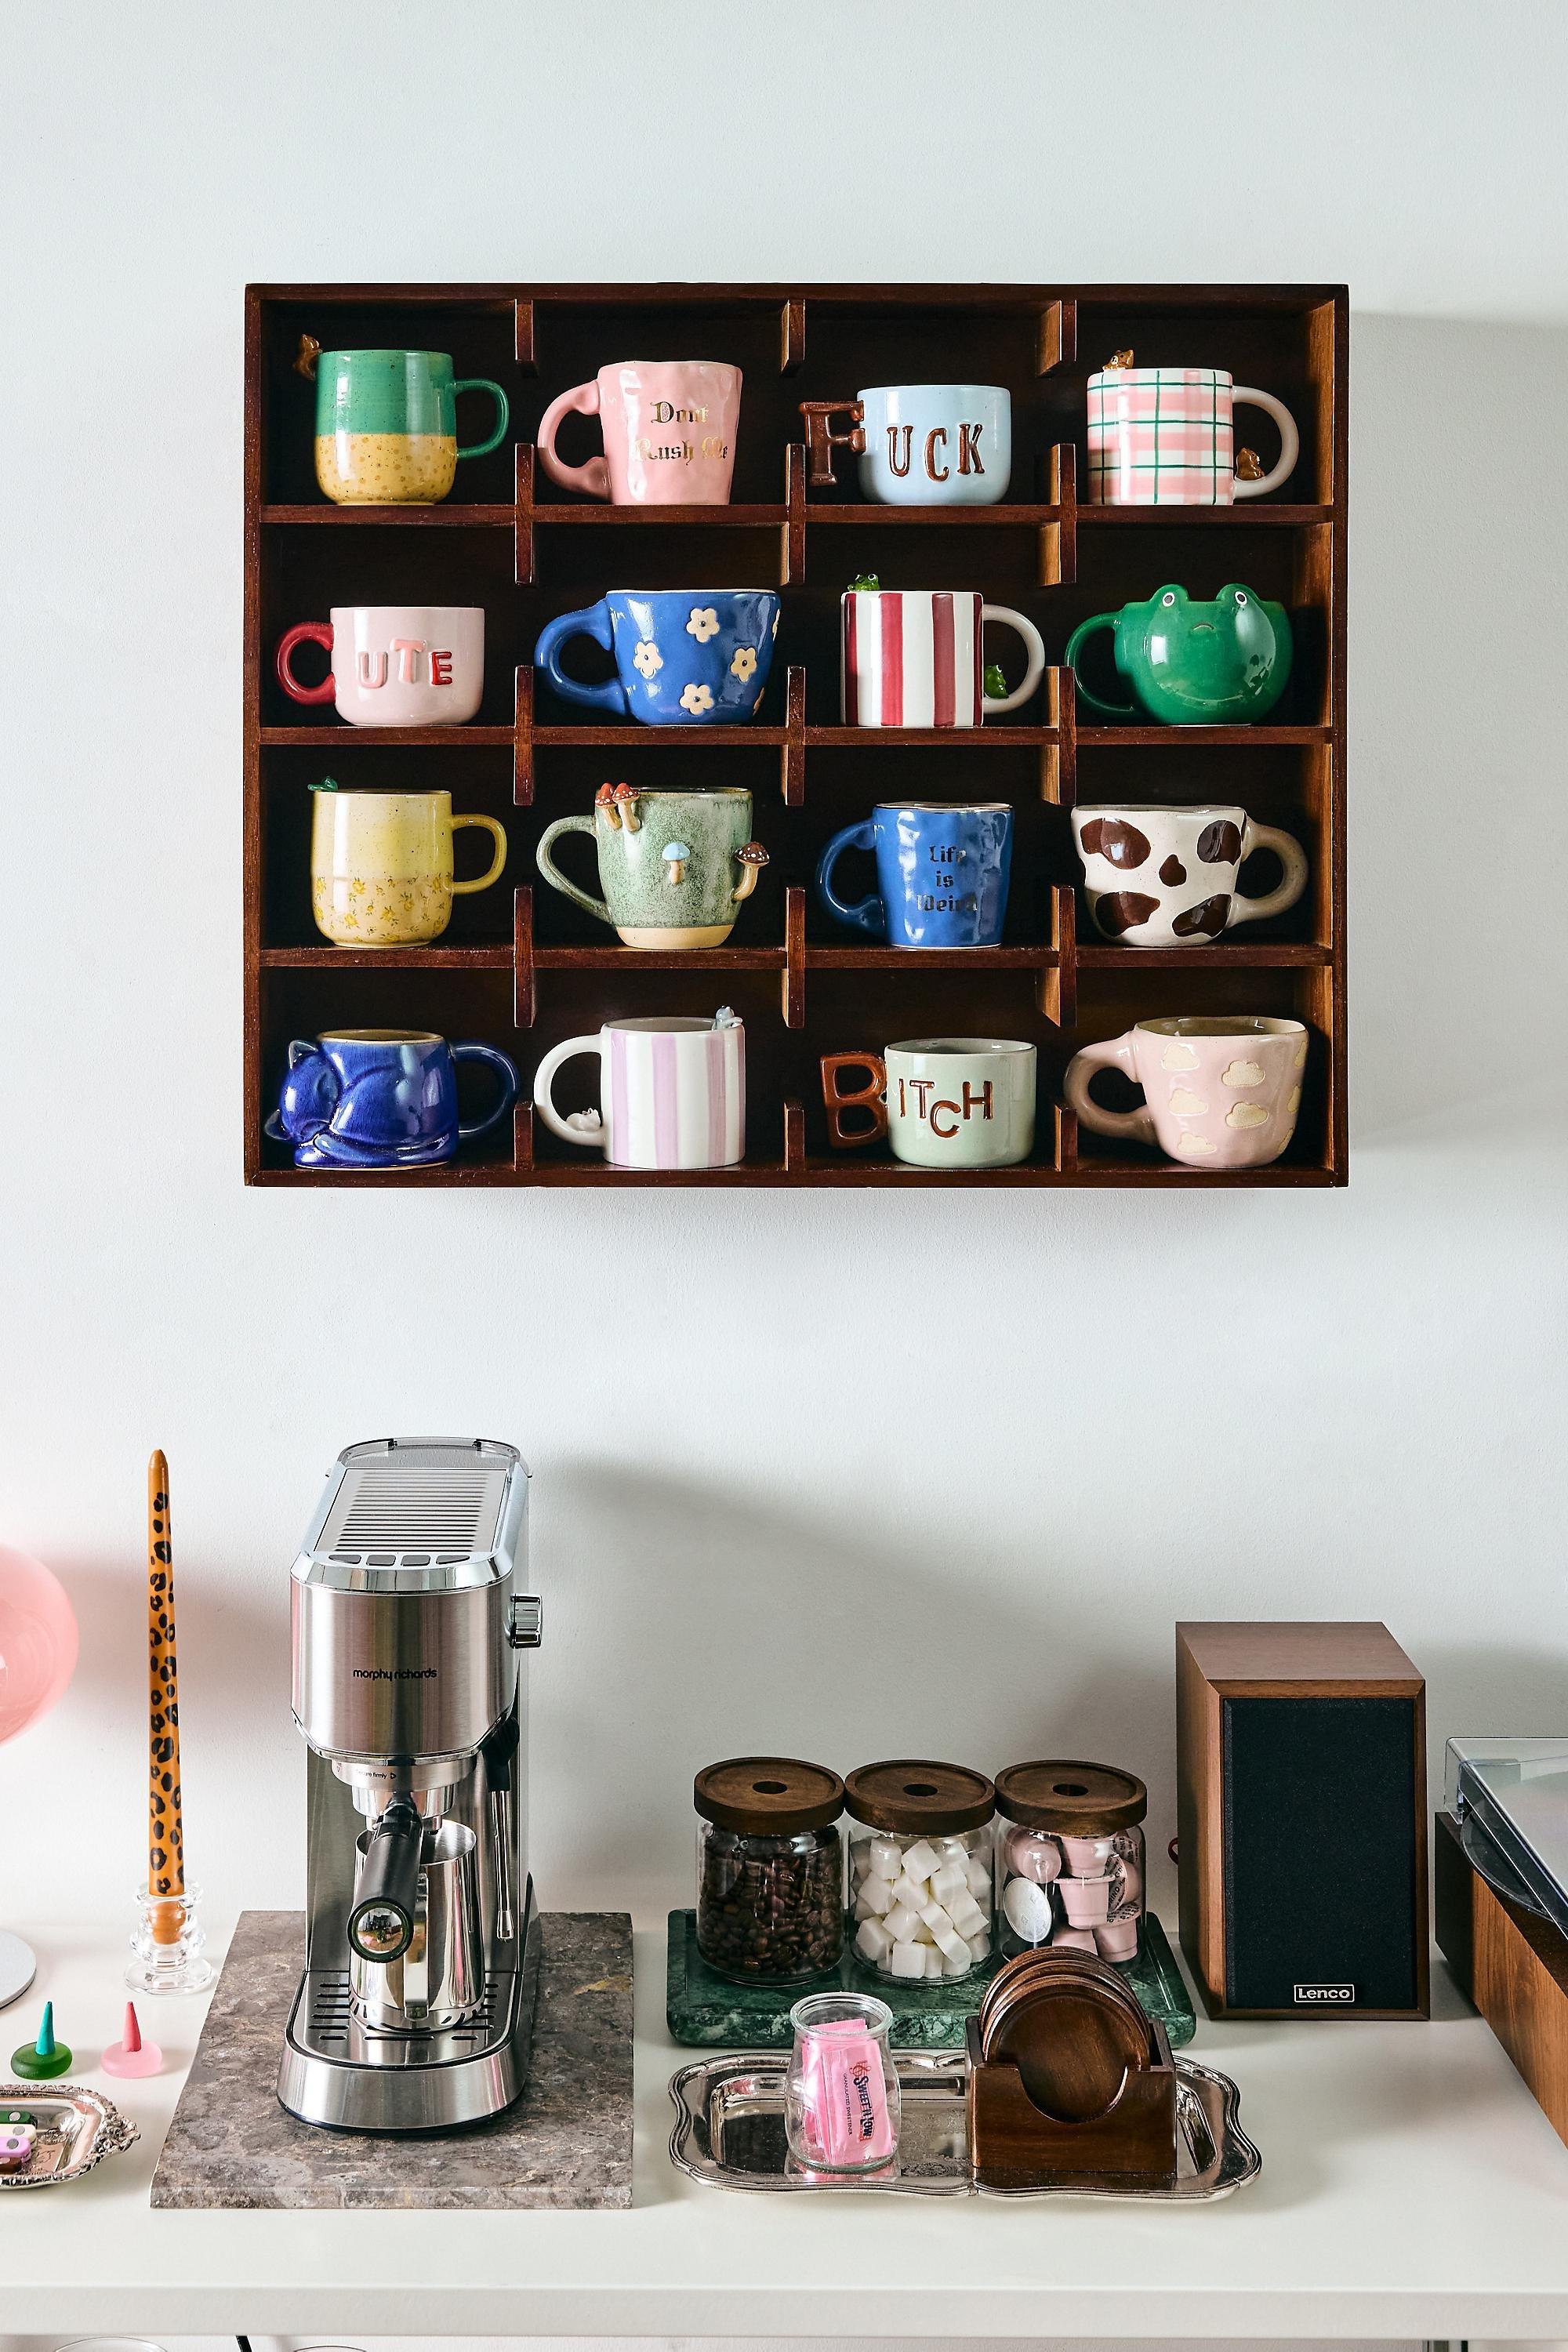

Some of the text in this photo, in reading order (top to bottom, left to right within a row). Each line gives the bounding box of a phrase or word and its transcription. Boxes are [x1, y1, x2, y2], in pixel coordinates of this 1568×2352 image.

[635, 436, 728, 466] Rush Me
[929, 845, 967, 863] Life
[935, 870, 954, 888] is
[916, 893, 978, 912] Weird
[353, 1668, 437, 1682] morphy richards
[1298, 1987, 1350, 1999] Lenco
